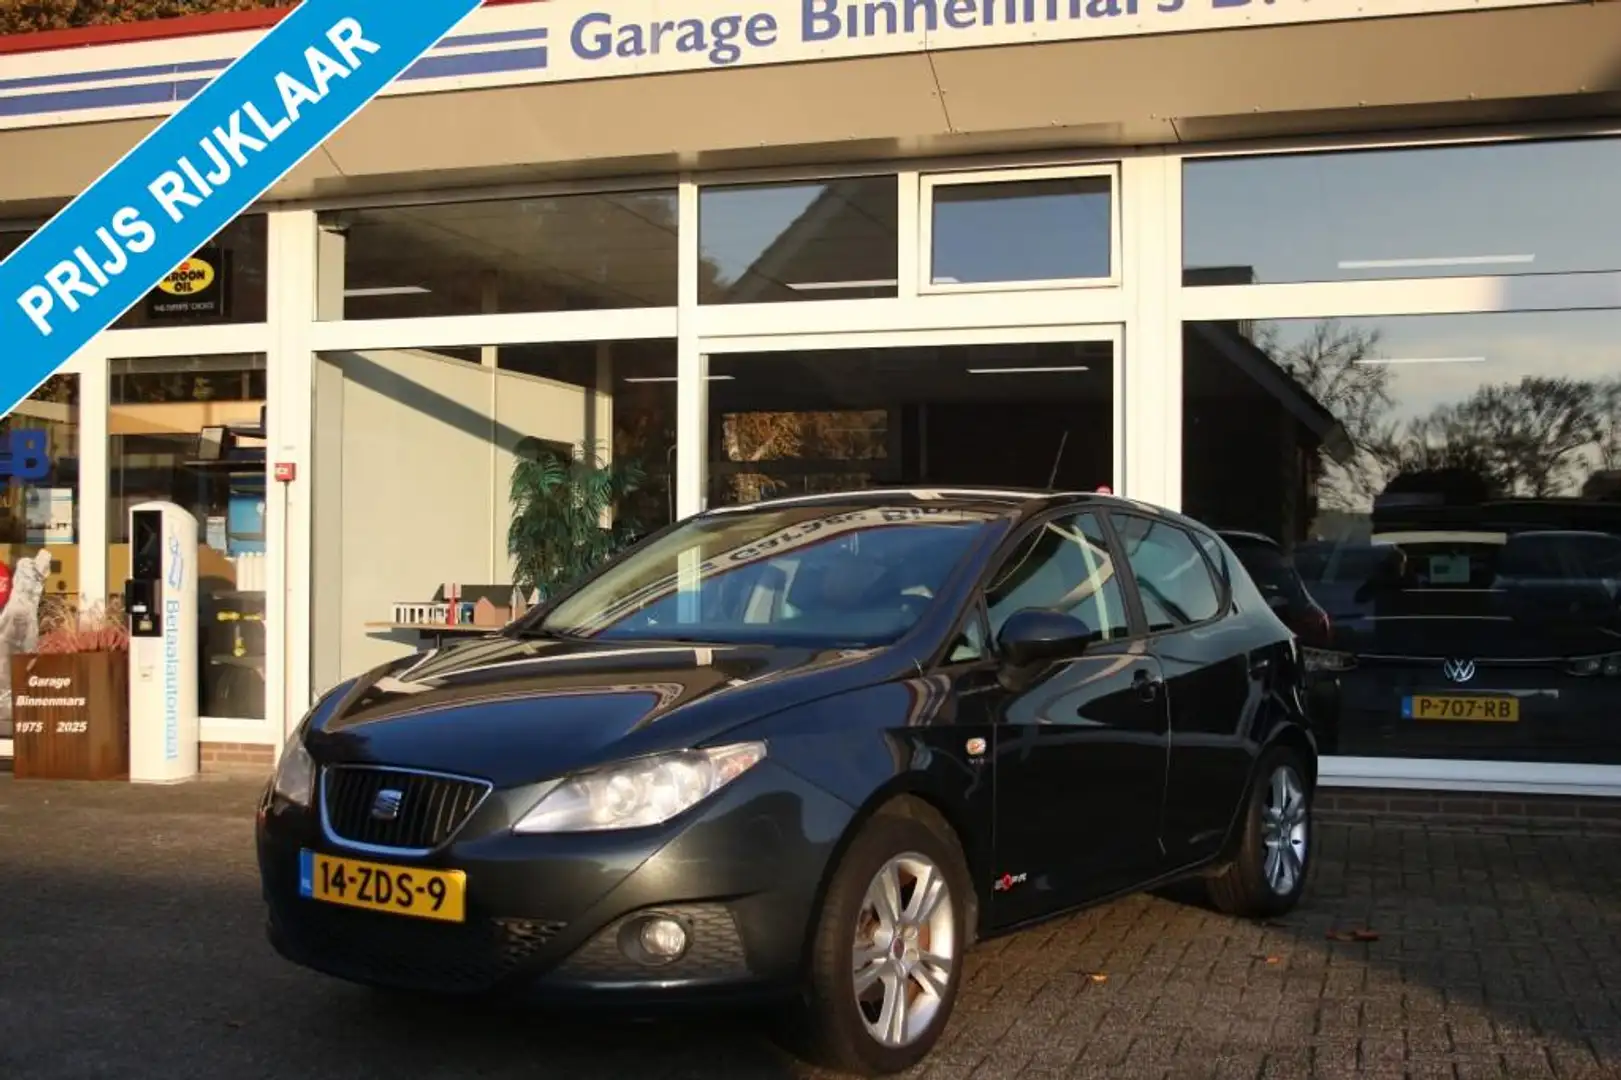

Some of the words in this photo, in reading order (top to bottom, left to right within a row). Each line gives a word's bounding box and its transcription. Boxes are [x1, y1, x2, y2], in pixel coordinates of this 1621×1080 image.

[570, 12, 778, 64] Garage
[162, 269, 206, 283] ROON
[174, 282, 194, 293] OIL
[28, 675, 71, 690] Garage
[15, 694, 86, 707] Binnenmars
[1420, 697, 1511, 718] P-707-RB
[15, 720, 44, 733] 1975
[56, 720, 88, 733] 2025
[319, 860, 447, 912] 14-ZDS-9
